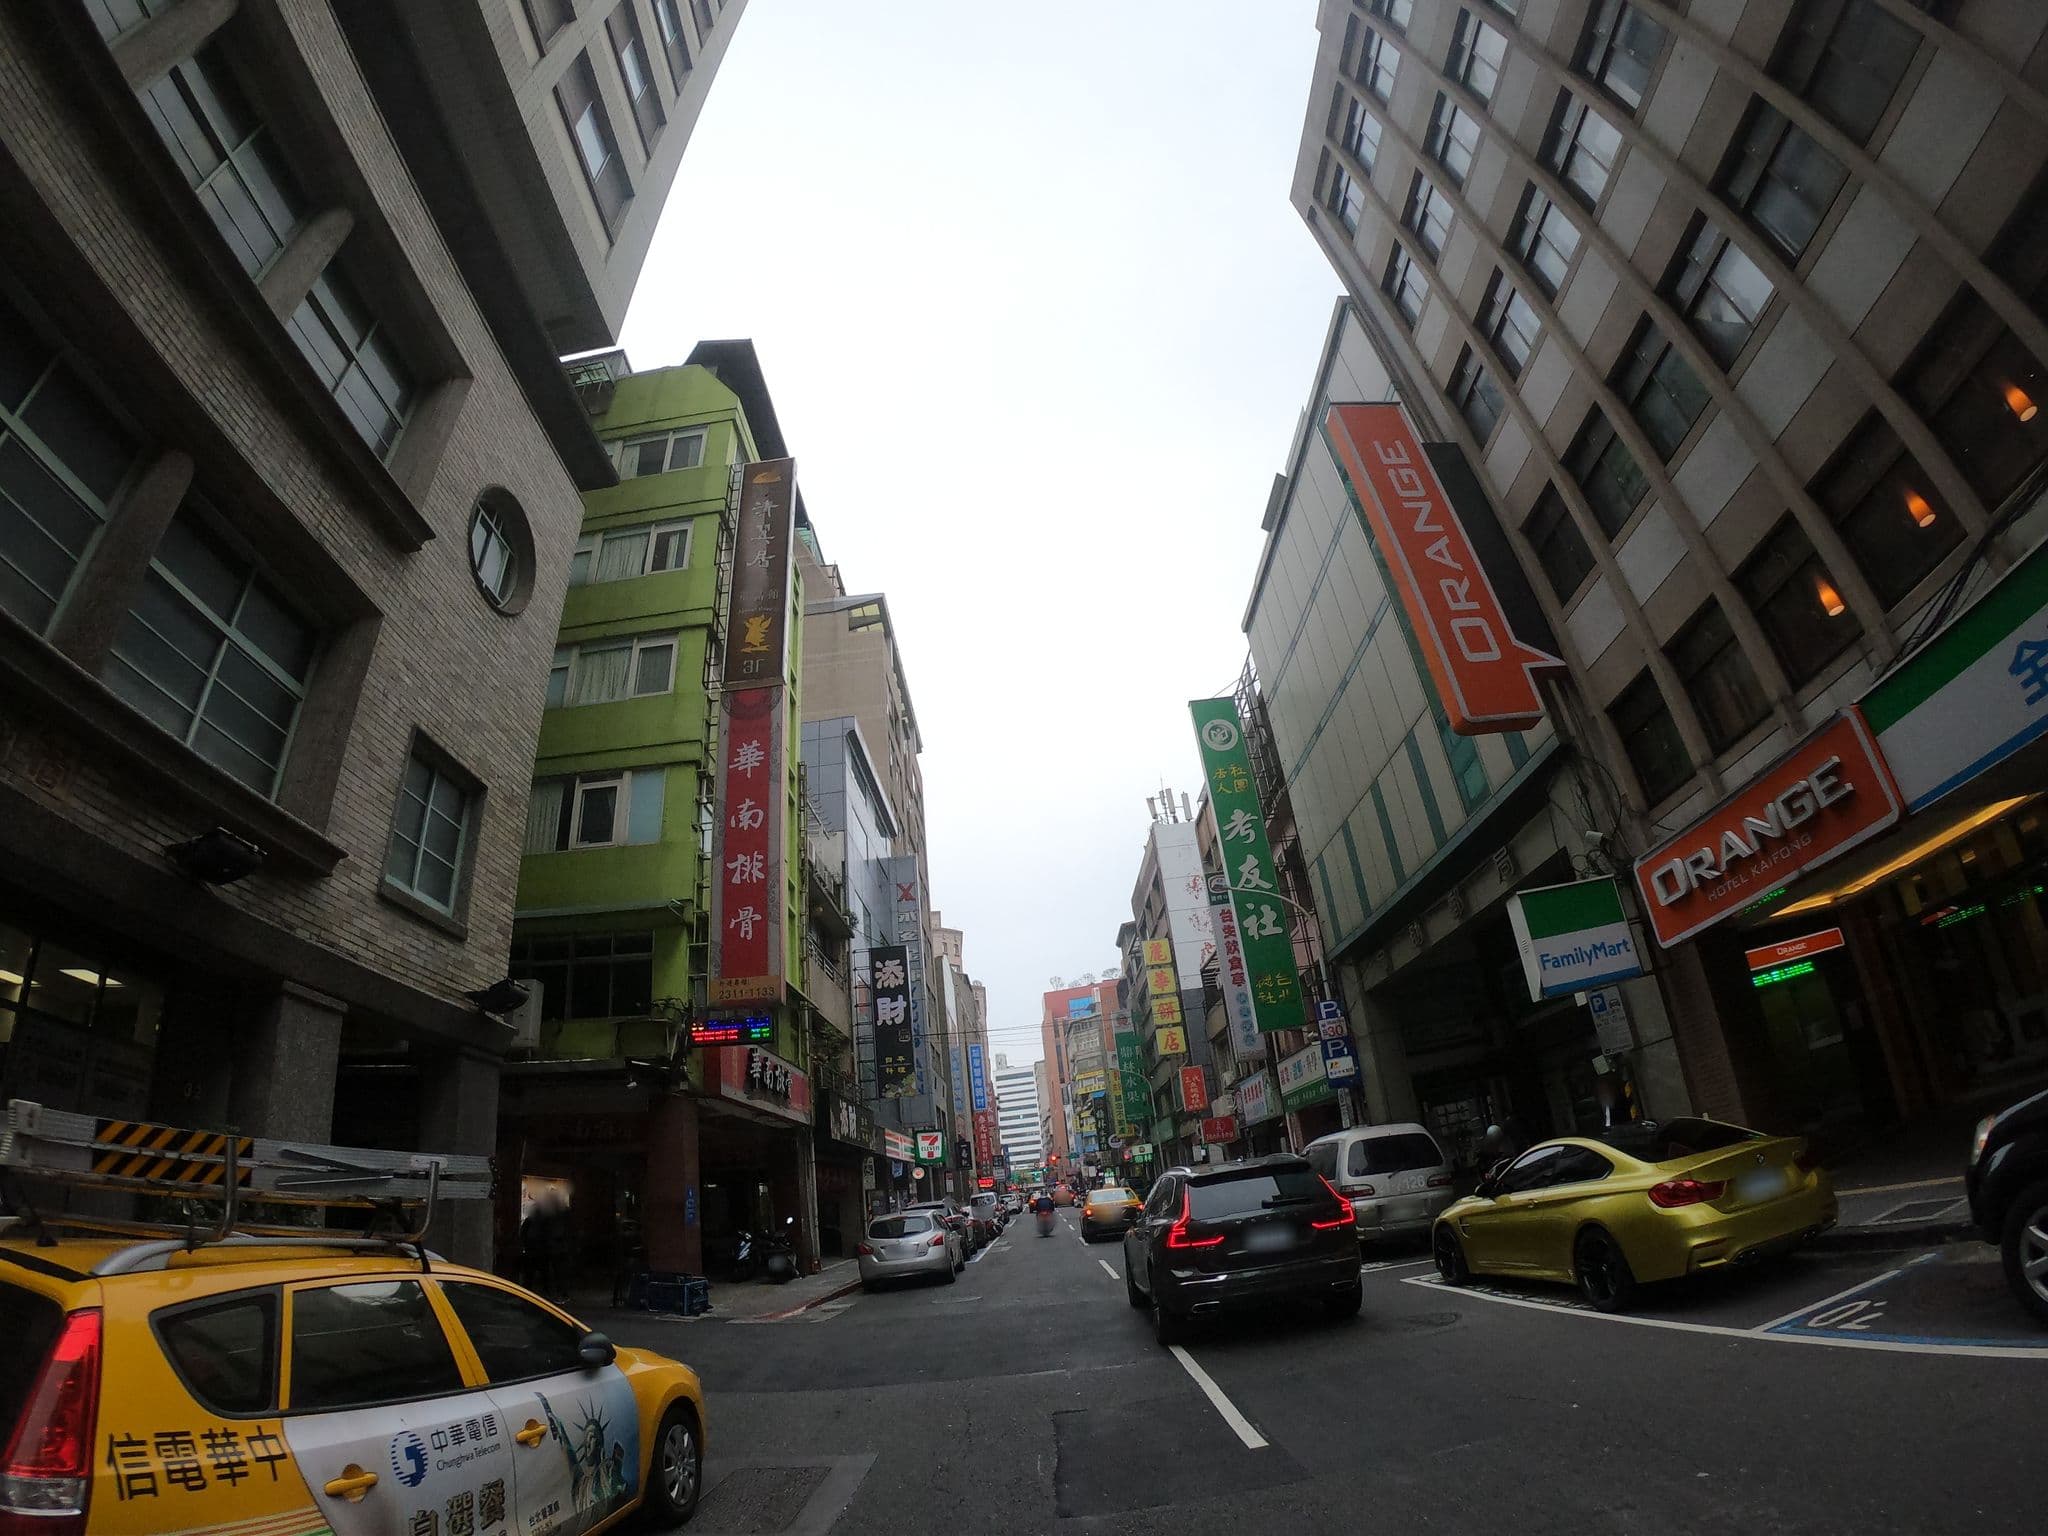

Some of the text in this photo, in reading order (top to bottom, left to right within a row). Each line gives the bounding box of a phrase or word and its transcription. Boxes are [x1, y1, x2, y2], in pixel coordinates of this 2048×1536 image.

[1373, 438, 1502, 663] ORANGE
[726, 738, 766, 941] 華南排骨
[1650, 755, 1856, 908] ORANGE
[1222, 808, 1284, 942] 考友社
[1707, 873, 1750, 903] HOTEL
[1750, 835, 1813, 878] KAIFONG
[1539, 938, 1632, 972] FamilyMart
[718, 986, 776, 1001] 2311-1133
[874, 958, 907, 1026] 添財
[429, 1413, 499, 1454] 中華電信
